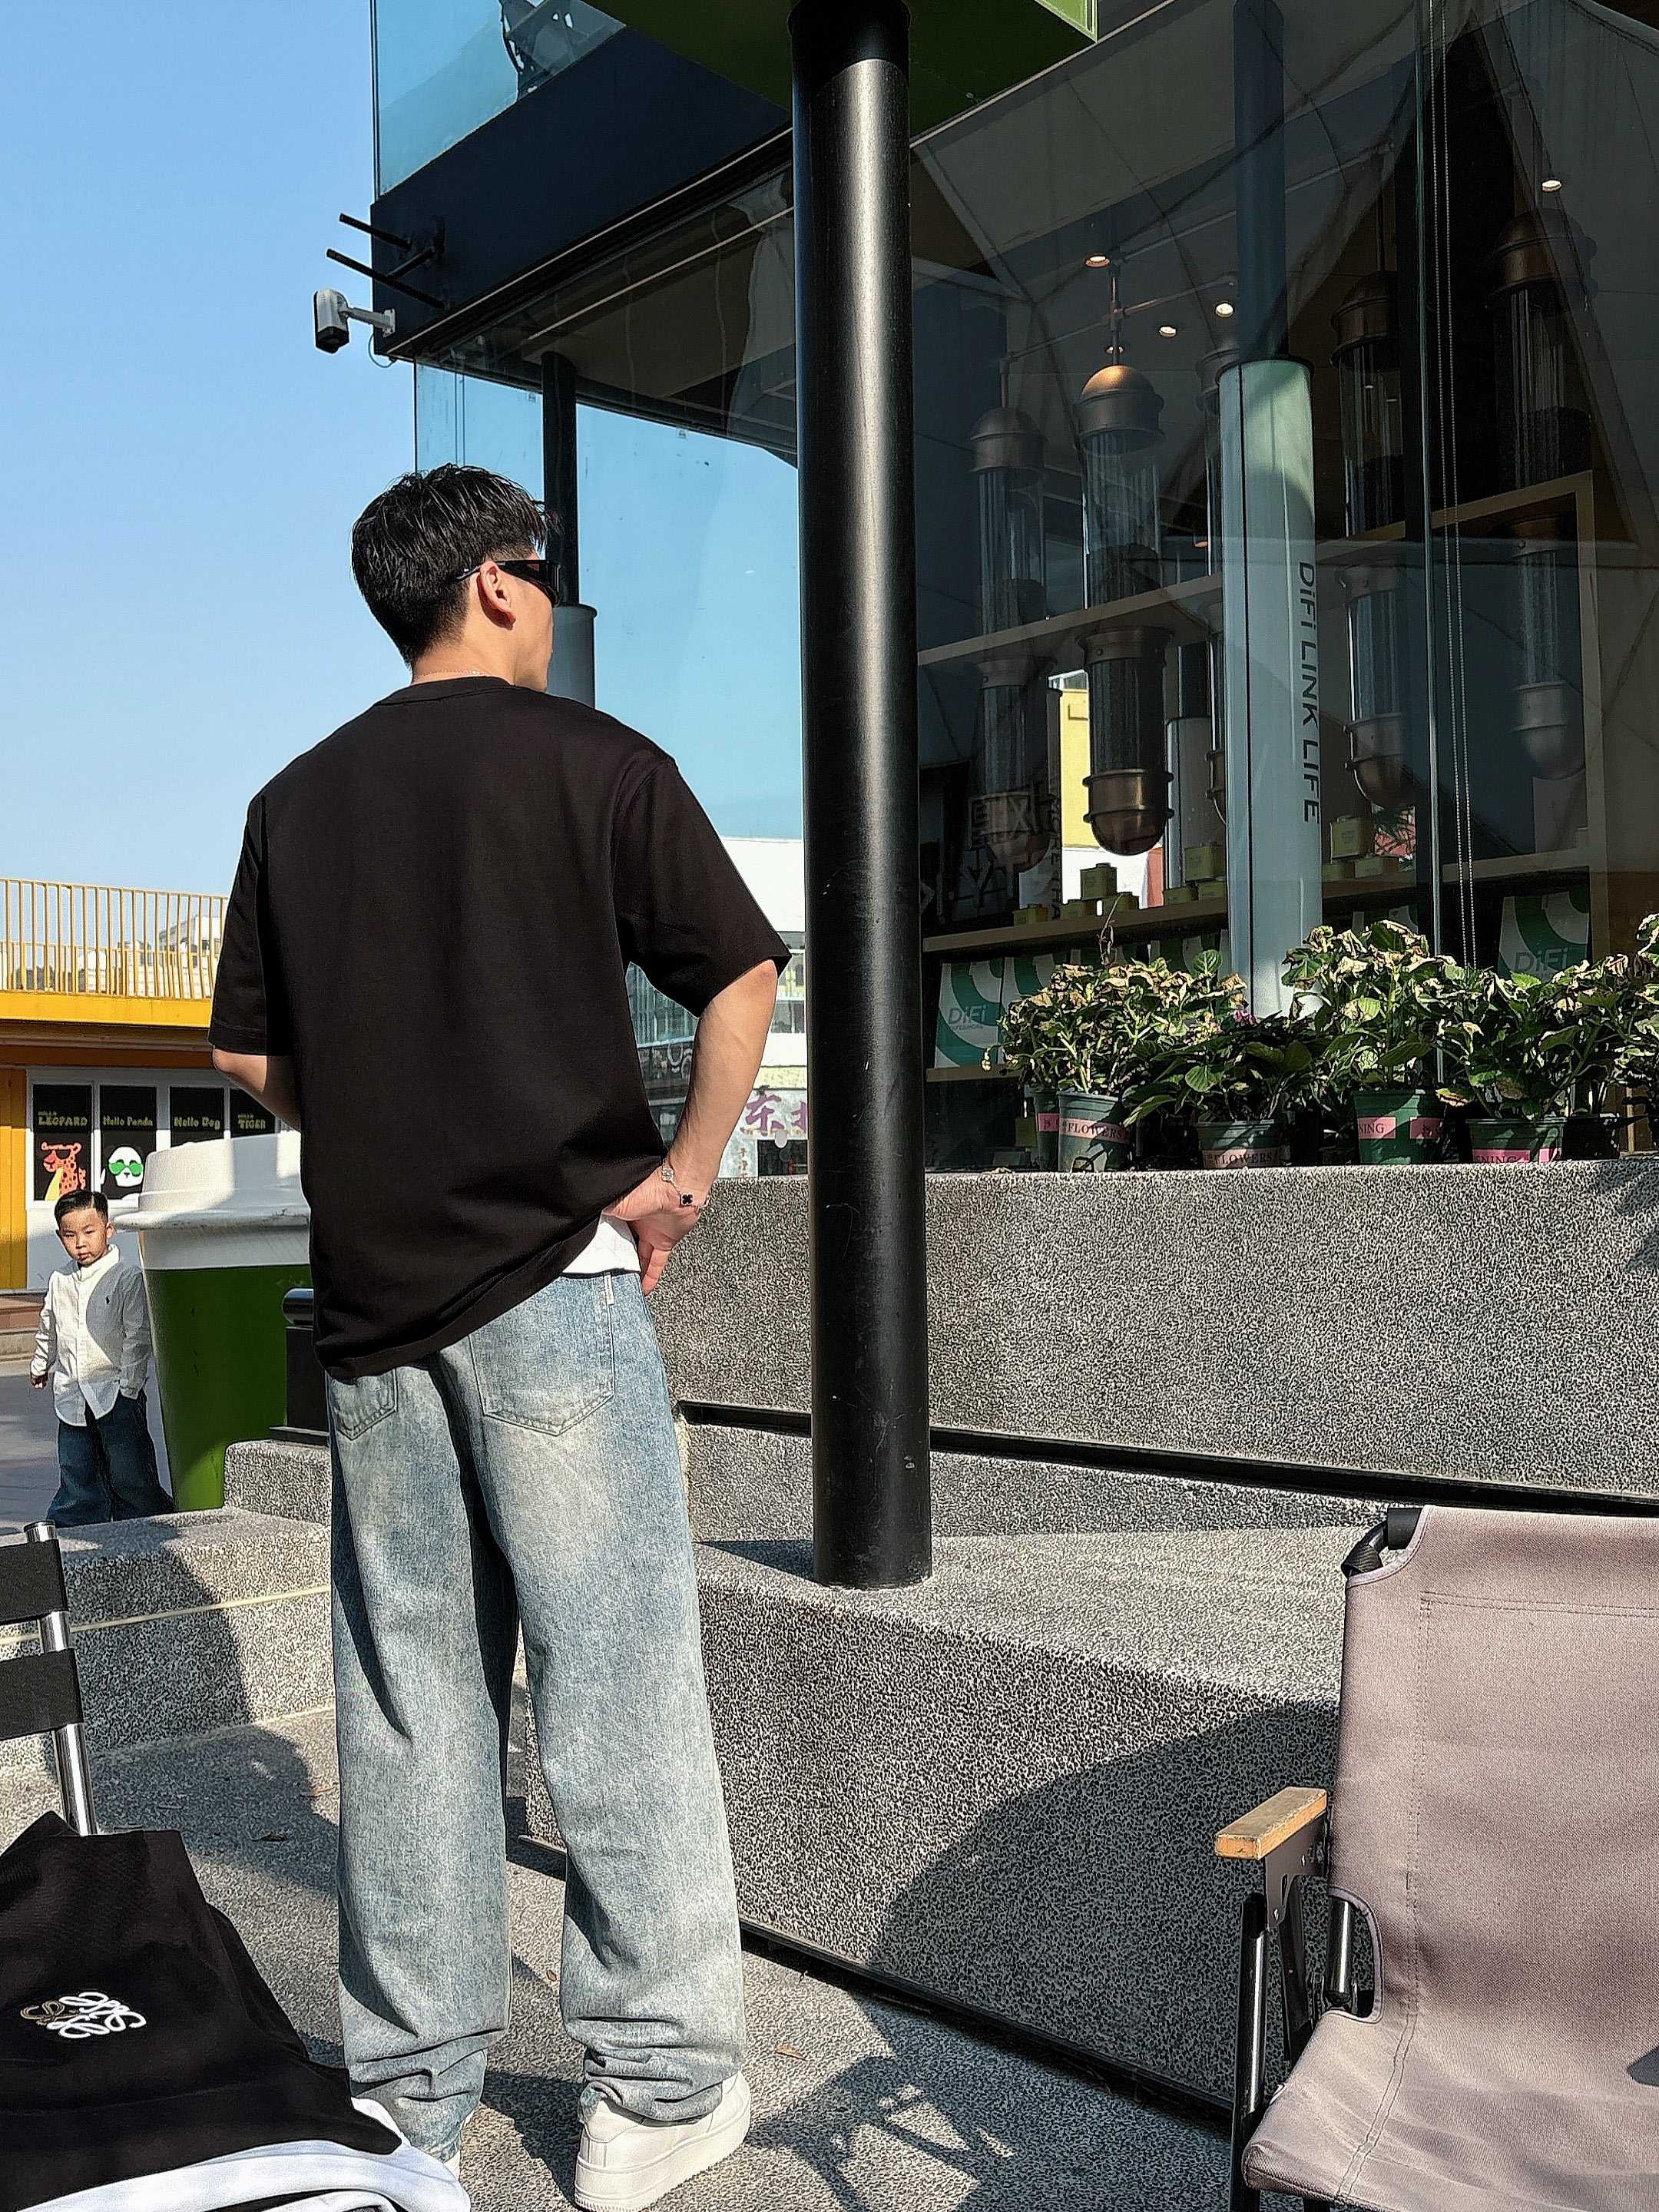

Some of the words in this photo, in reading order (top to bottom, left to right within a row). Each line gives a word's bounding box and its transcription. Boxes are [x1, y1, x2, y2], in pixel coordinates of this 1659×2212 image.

[1301, 640, 1318, 730] LINK
[1303, 739, 1320, 824] LIFE
[38, 1116, 88, 1126] LEOPARD
[103, 1114, 124, 1126] Hello
[127, 1116, 153, 1126] Panda
[237, 1119, 266, 1130] TIGER
[1068, 1122, 1121, 1139] FLOWERS
[1215, 1154, 1273, 1164] FLOWERS
